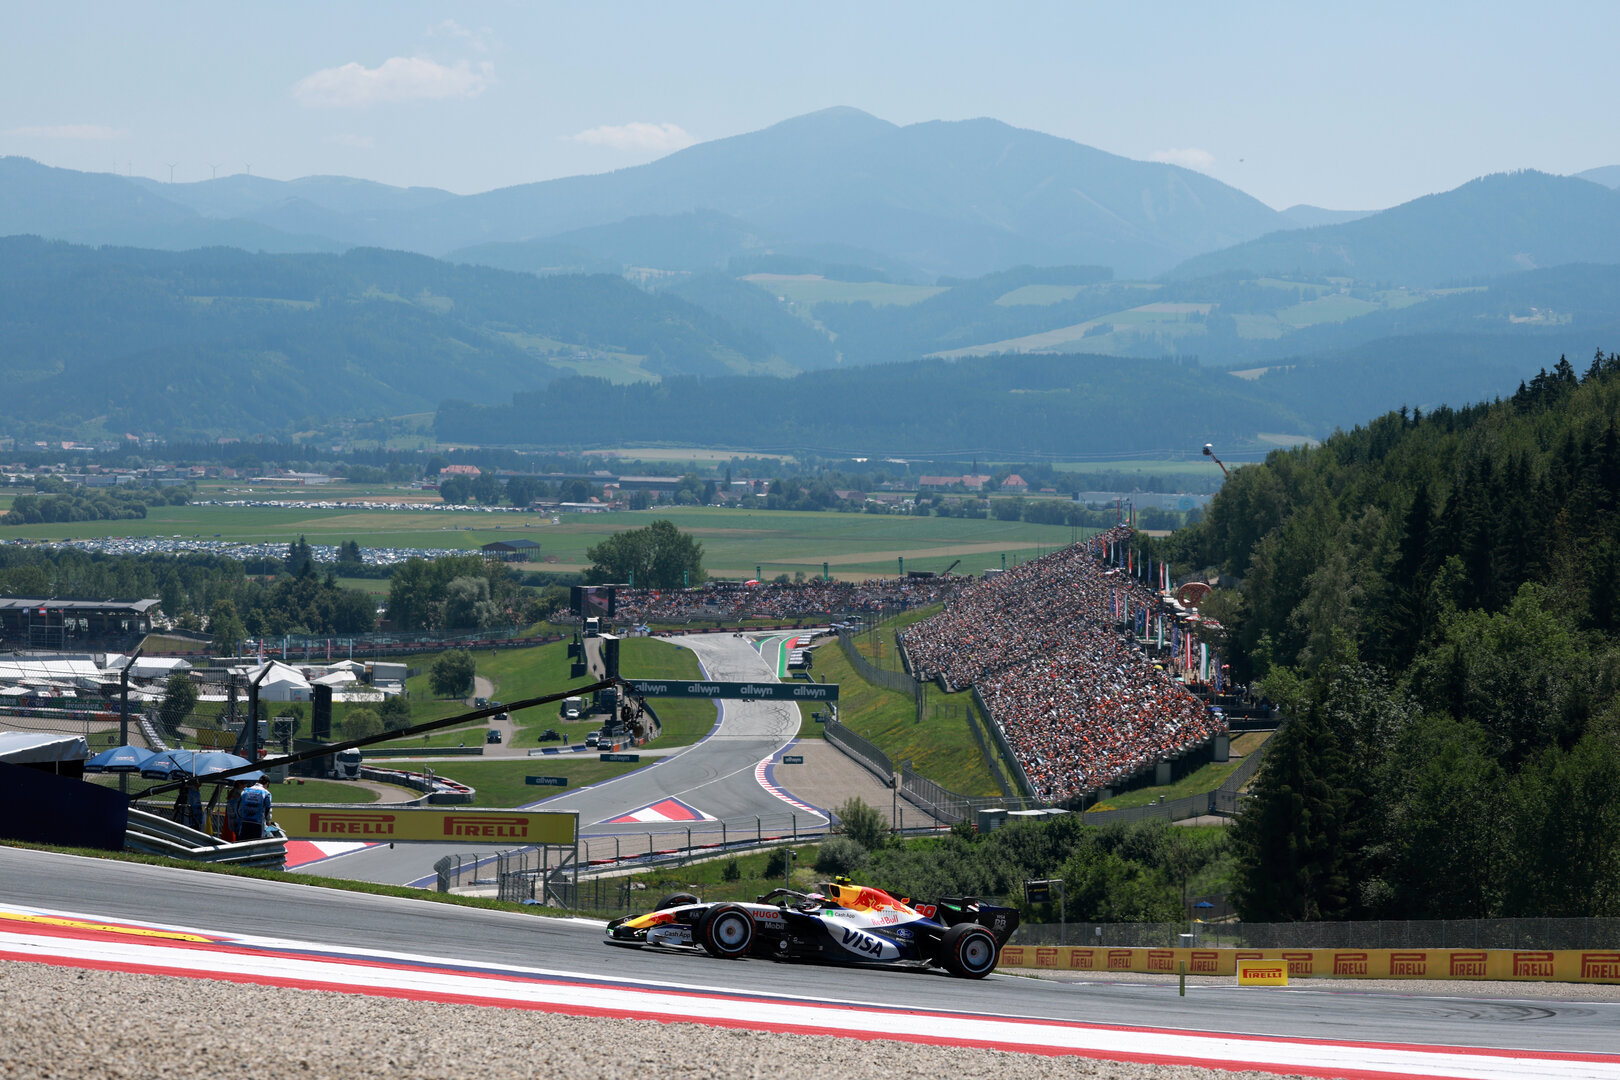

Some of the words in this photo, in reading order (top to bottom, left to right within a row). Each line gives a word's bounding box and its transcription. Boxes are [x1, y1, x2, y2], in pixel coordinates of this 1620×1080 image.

[688, 683, 720, 696] allwyn
[740, 685, 773, 697] allwyn
[793, 686, 826, 698] allwyn
[309, 813, 396, 834] PIRELLI
[443, 816, 530, 837] PIRELLI
[752, 910, 779, 919] HUGO
[679, 931, 691, 939] App
[764, 922, 785, 930] Mobil
[842, 926, 883, 958] VISA
[1002, 948, 1024, 966] PIRELLI
[1036, 948, 1058, 967] PIRELLI
[1070, 950, 1094, 968] PIRELLI
[1108, 950, 1132, 969] PIRELLI
[1147, 950, 1174, 970] PIRELLI
[1190, 952, 1218, 972] PIRELLI
[1333, 953, 1368, 975] PIRELLI
[1390, 953, 1426, 976] PIRELLI
[1450, 953, 1487, 976] PIRELLI
[1513, 952, 1554, 977] PIRELLI
[1581, 953, 1620, 978] PIRELL
[1242, 968, 1282, 978] PIRELLI
